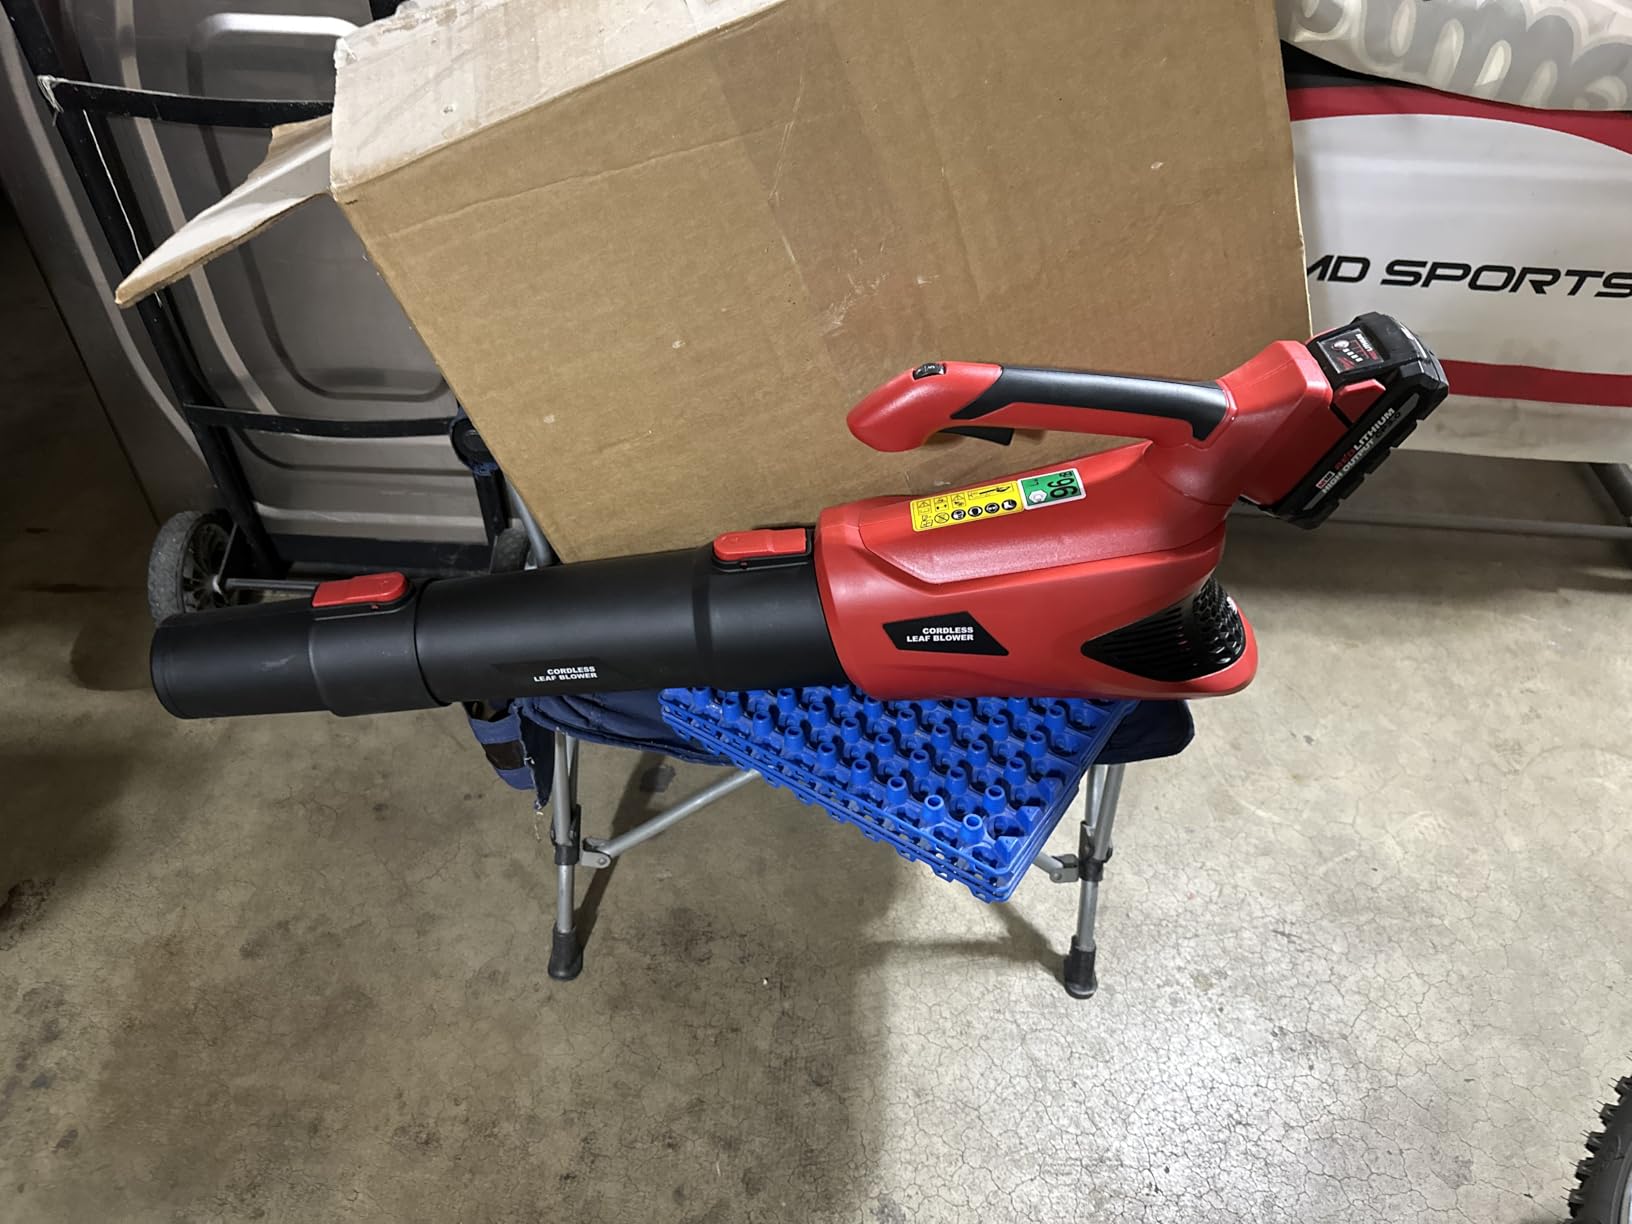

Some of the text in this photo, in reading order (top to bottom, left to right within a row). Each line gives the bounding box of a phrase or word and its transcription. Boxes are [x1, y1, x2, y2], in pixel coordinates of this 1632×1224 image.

[1380, 259, 1632, 298] SPORTS
[1321, 472, 1344, 494] HIGH
[1342, 438, 1375, 472] OUTPUT
[1047, 478, 1078, 498] 96
[922, 626, 974, 635] CORDLESS
[906, 634, 974, 643] LEAF BLOWER
[546, 665, 596, 675] CORDLESS
[558, 672, 598, 681] BLOWER
